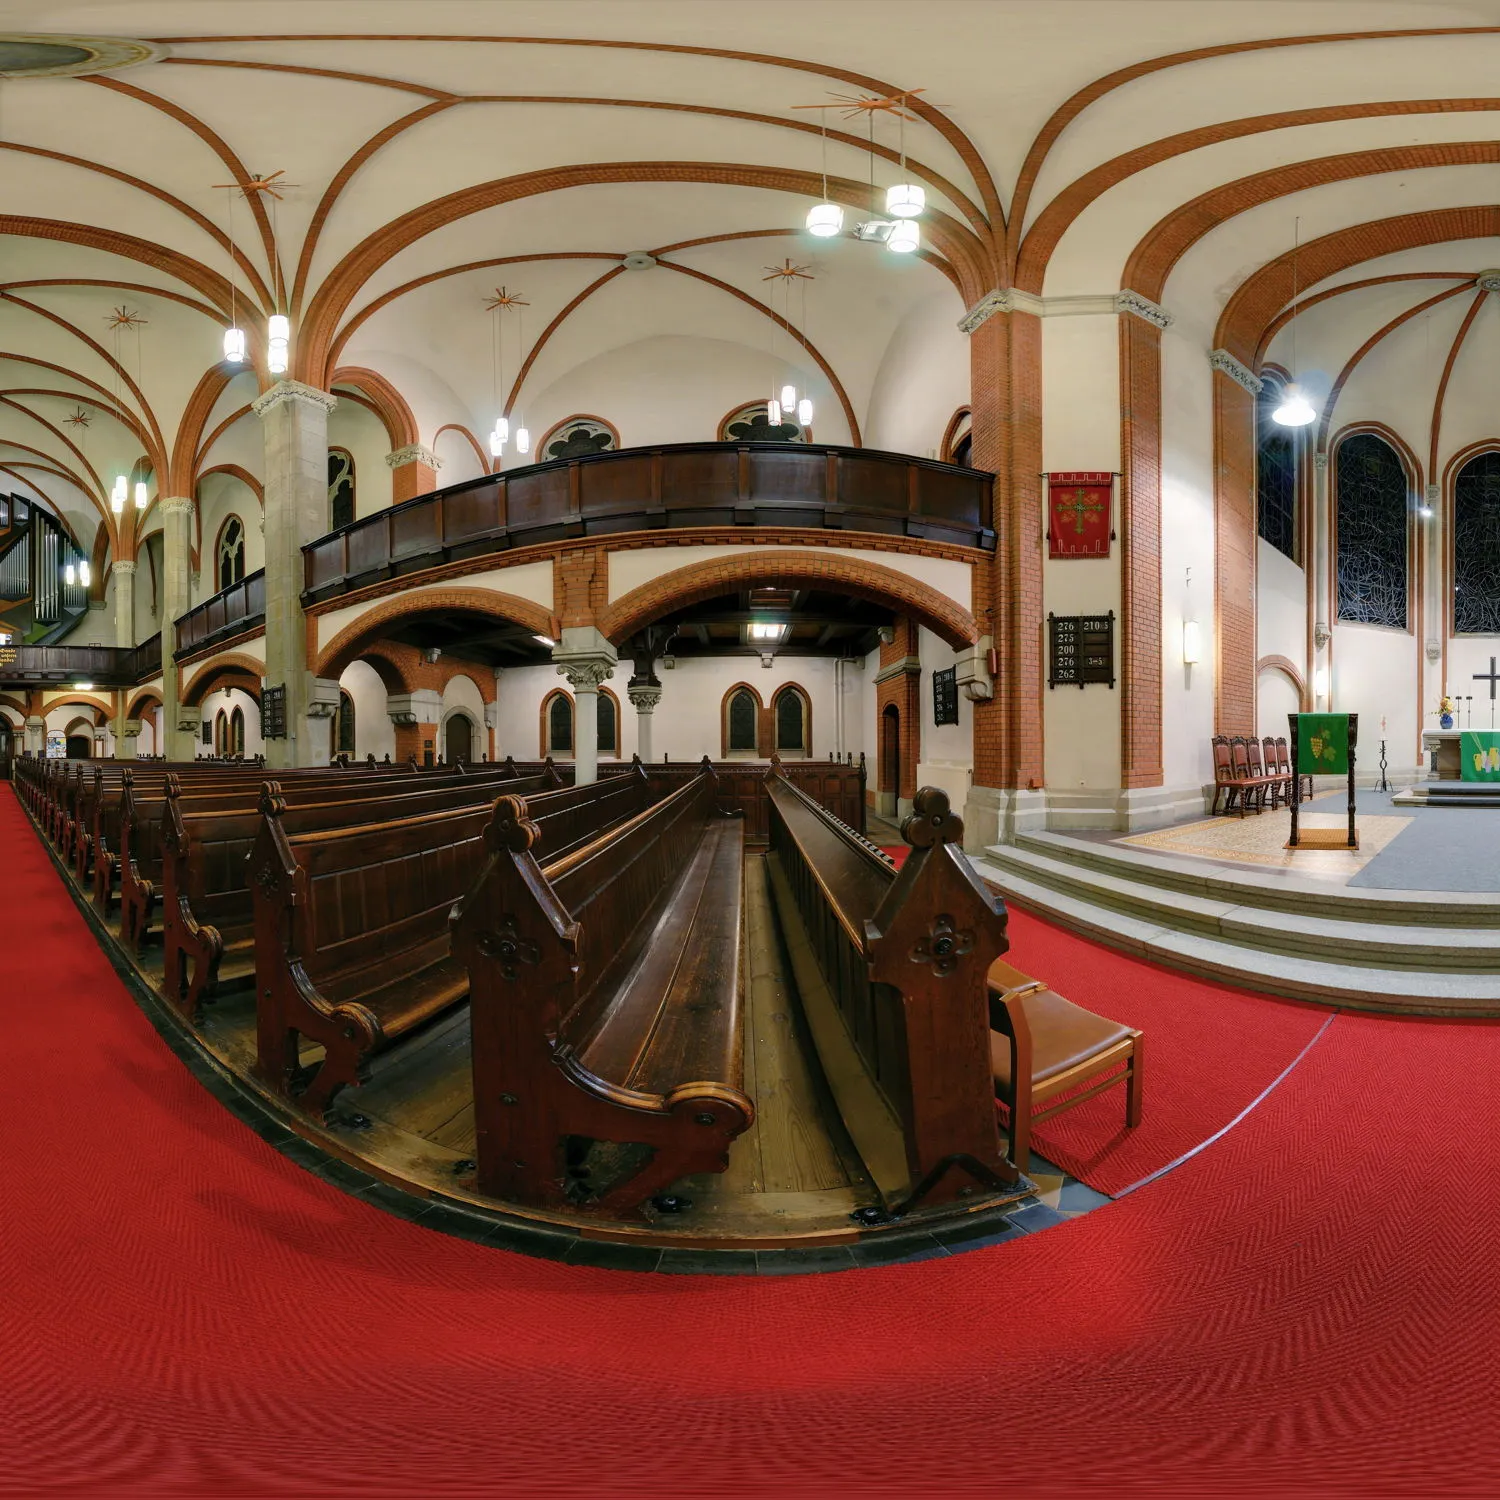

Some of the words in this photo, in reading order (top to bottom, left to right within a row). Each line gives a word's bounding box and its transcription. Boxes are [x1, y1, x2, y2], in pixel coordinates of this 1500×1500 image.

[1057, 622, 1074, 631] 276
[1083, 621, 1100, 631] 210
[1057, 633, 1074, 643] 275
[1057, 645, 1074, 655] 200
[1058, 657, 1075, 667] 276
[1088, 657, 1103, 666] 3-5
[1058, 669, 1075, 679] 262
